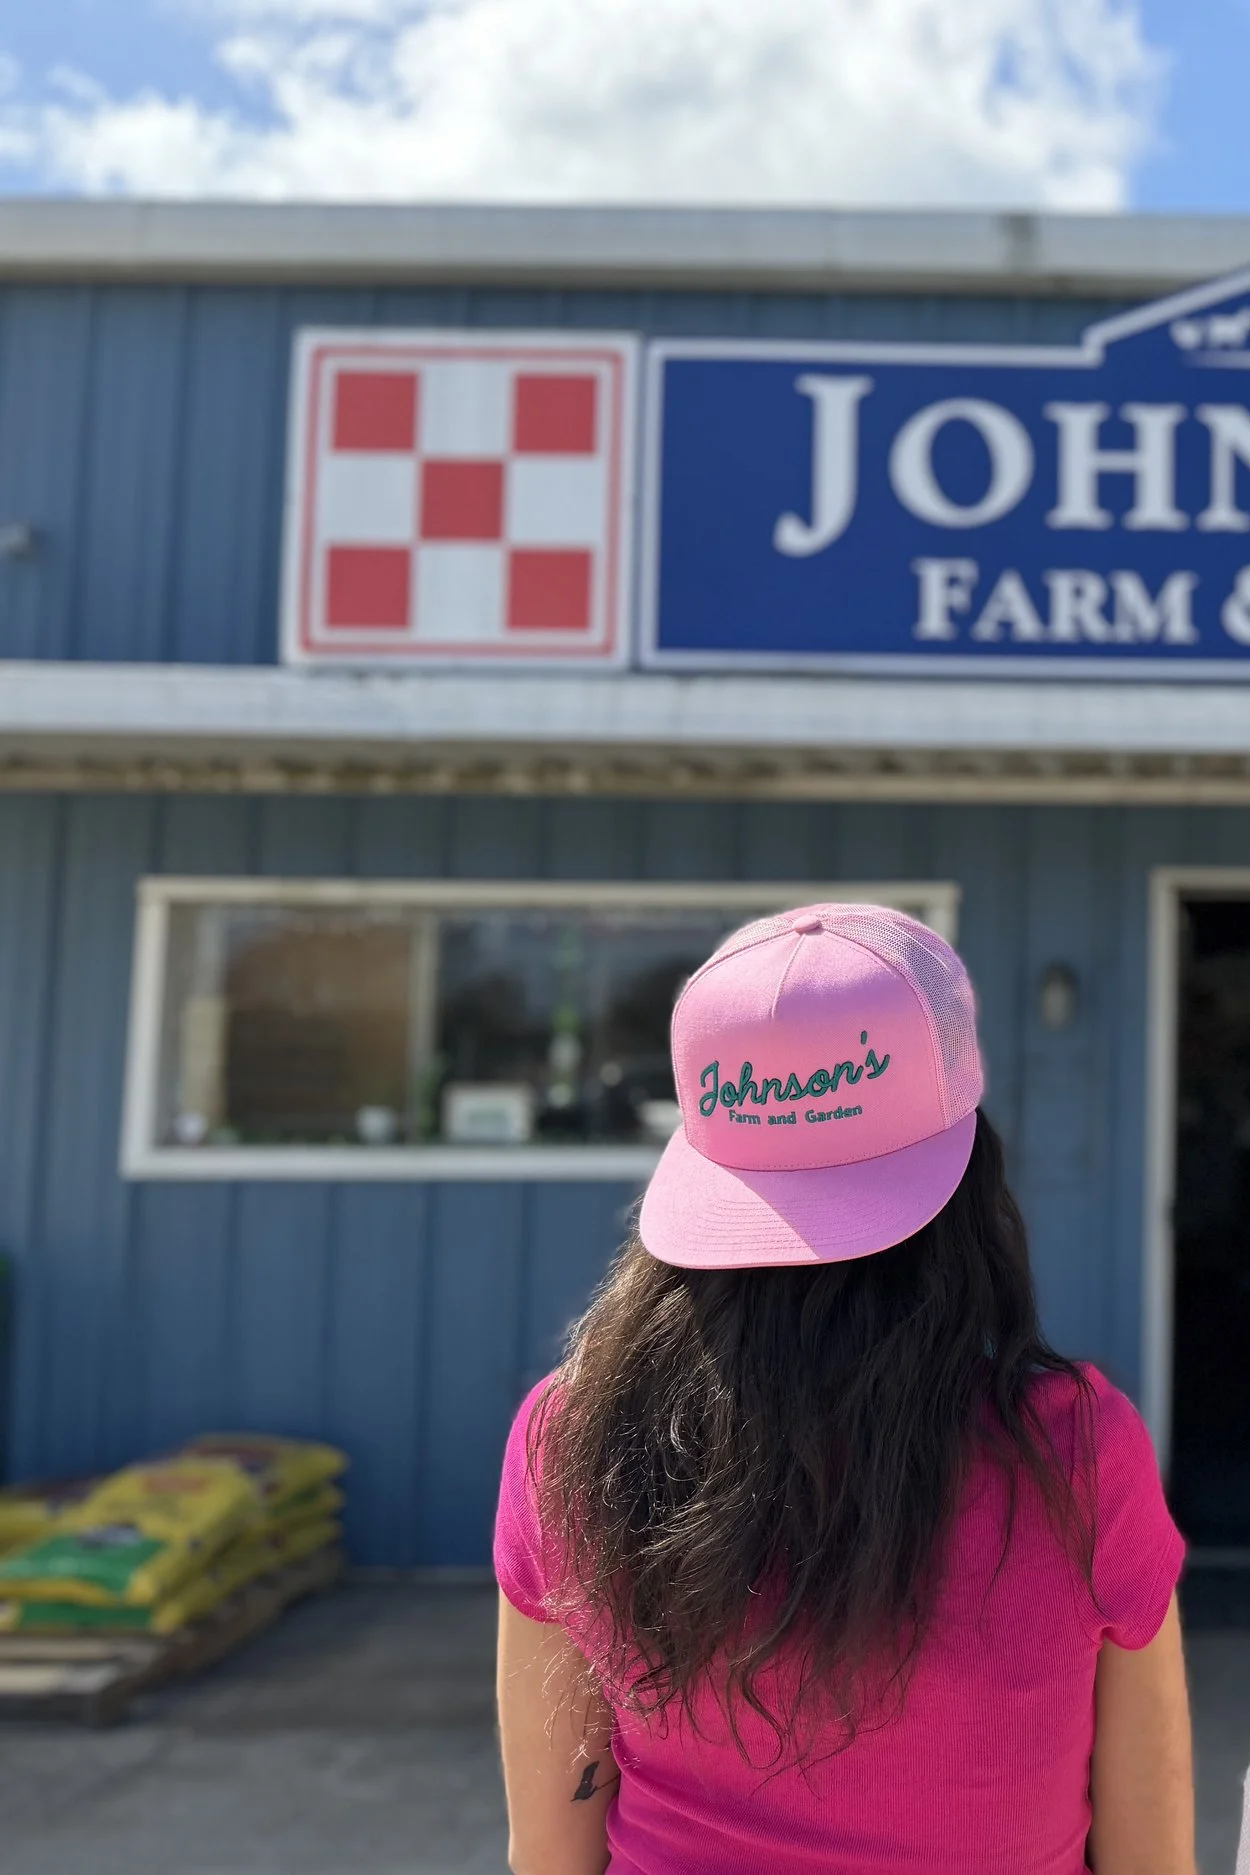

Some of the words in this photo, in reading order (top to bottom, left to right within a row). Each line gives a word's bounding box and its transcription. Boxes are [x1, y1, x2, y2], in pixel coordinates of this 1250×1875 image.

[912, 557, 1198, 645] FARM
[699, 1030, 890, 1117] Johnson's
[729, 1110, 761, 1125] Farm
[767, 1112, 796, 1125] and
[805, 1104, 862, 1123] Garden
